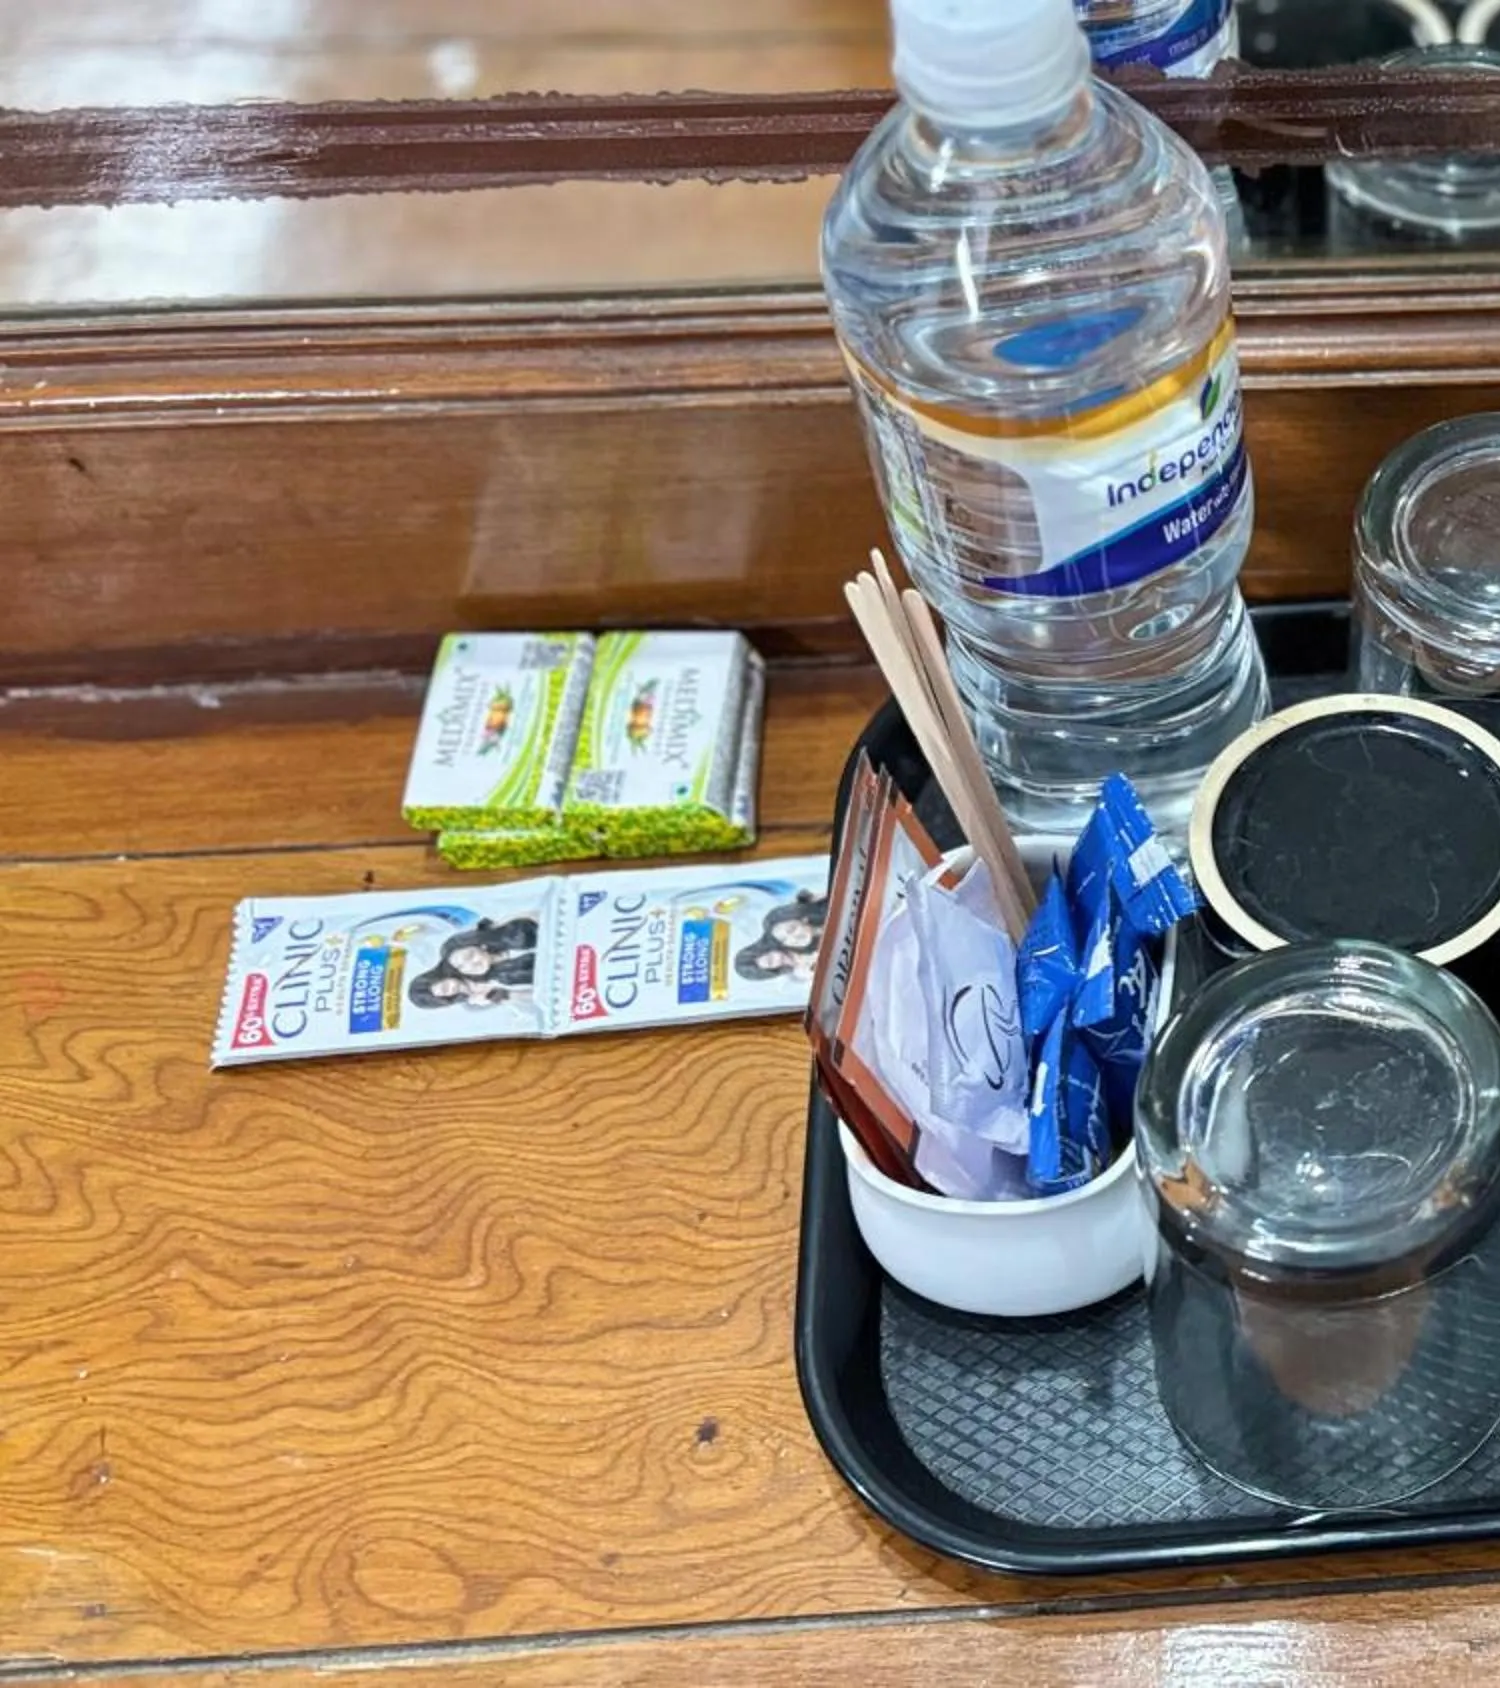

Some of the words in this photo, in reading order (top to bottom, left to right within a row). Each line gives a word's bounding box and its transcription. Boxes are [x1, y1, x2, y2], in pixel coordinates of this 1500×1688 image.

[1163, 498, 1216, 544] Water
[272, 917, 325, 1039] CLINIC
[605, 892, 646, 1008] CLINIC
[681, 932, 697, 986] STRONG
[351, 959, 371, 1015] STRONG
